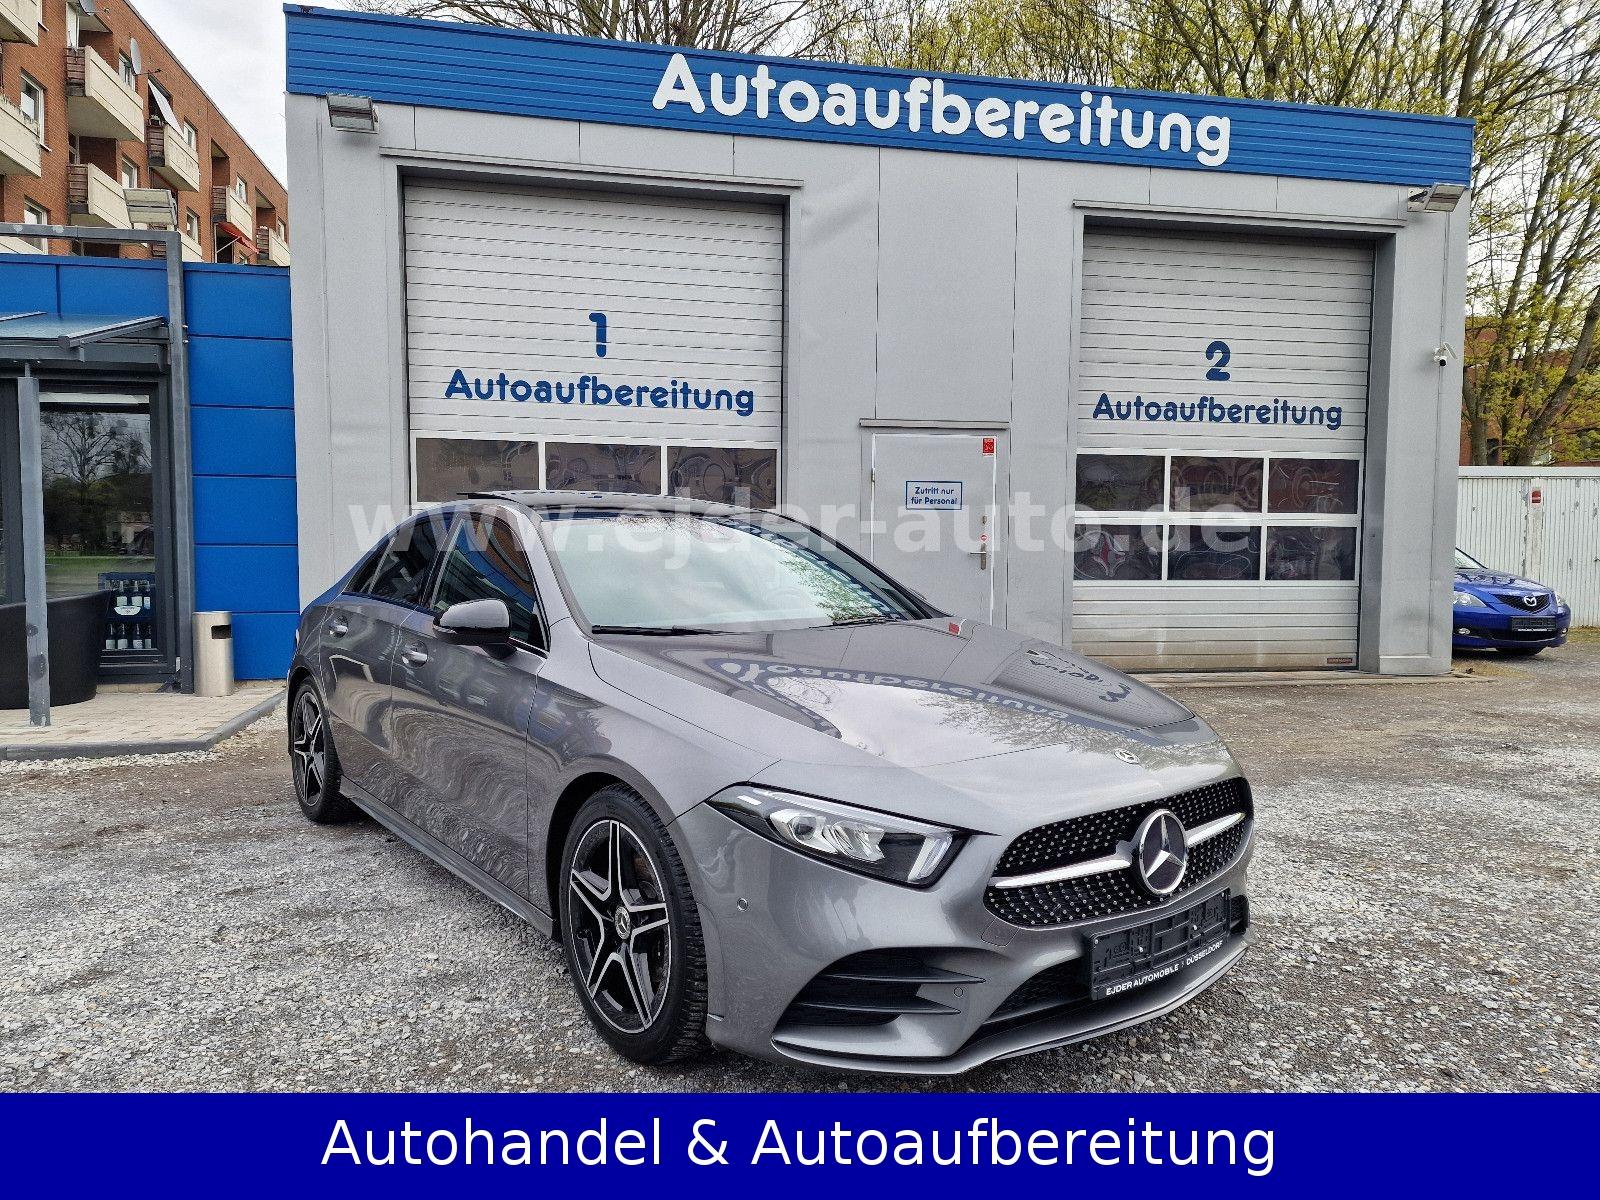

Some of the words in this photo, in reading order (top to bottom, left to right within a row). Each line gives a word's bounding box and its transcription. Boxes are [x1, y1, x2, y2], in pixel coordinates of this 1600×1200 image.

[652, 53, 1231, 167] Autoaufbereitung
[588, 312, 607, 358] 1
[1206, 341, 1230, 382] 2
[445, 369, 755, 416] Autoaufbereitung
[1093, 393, 1342, 431] Autoaufbereitung
[911, 496, 922, 504] für
[1106, 981, 1133, 996] EJDER
[1133, 963, 1180, 987] AUTOMOBILE
[1186, 940, 1223, 965] DÜSSELDORF
